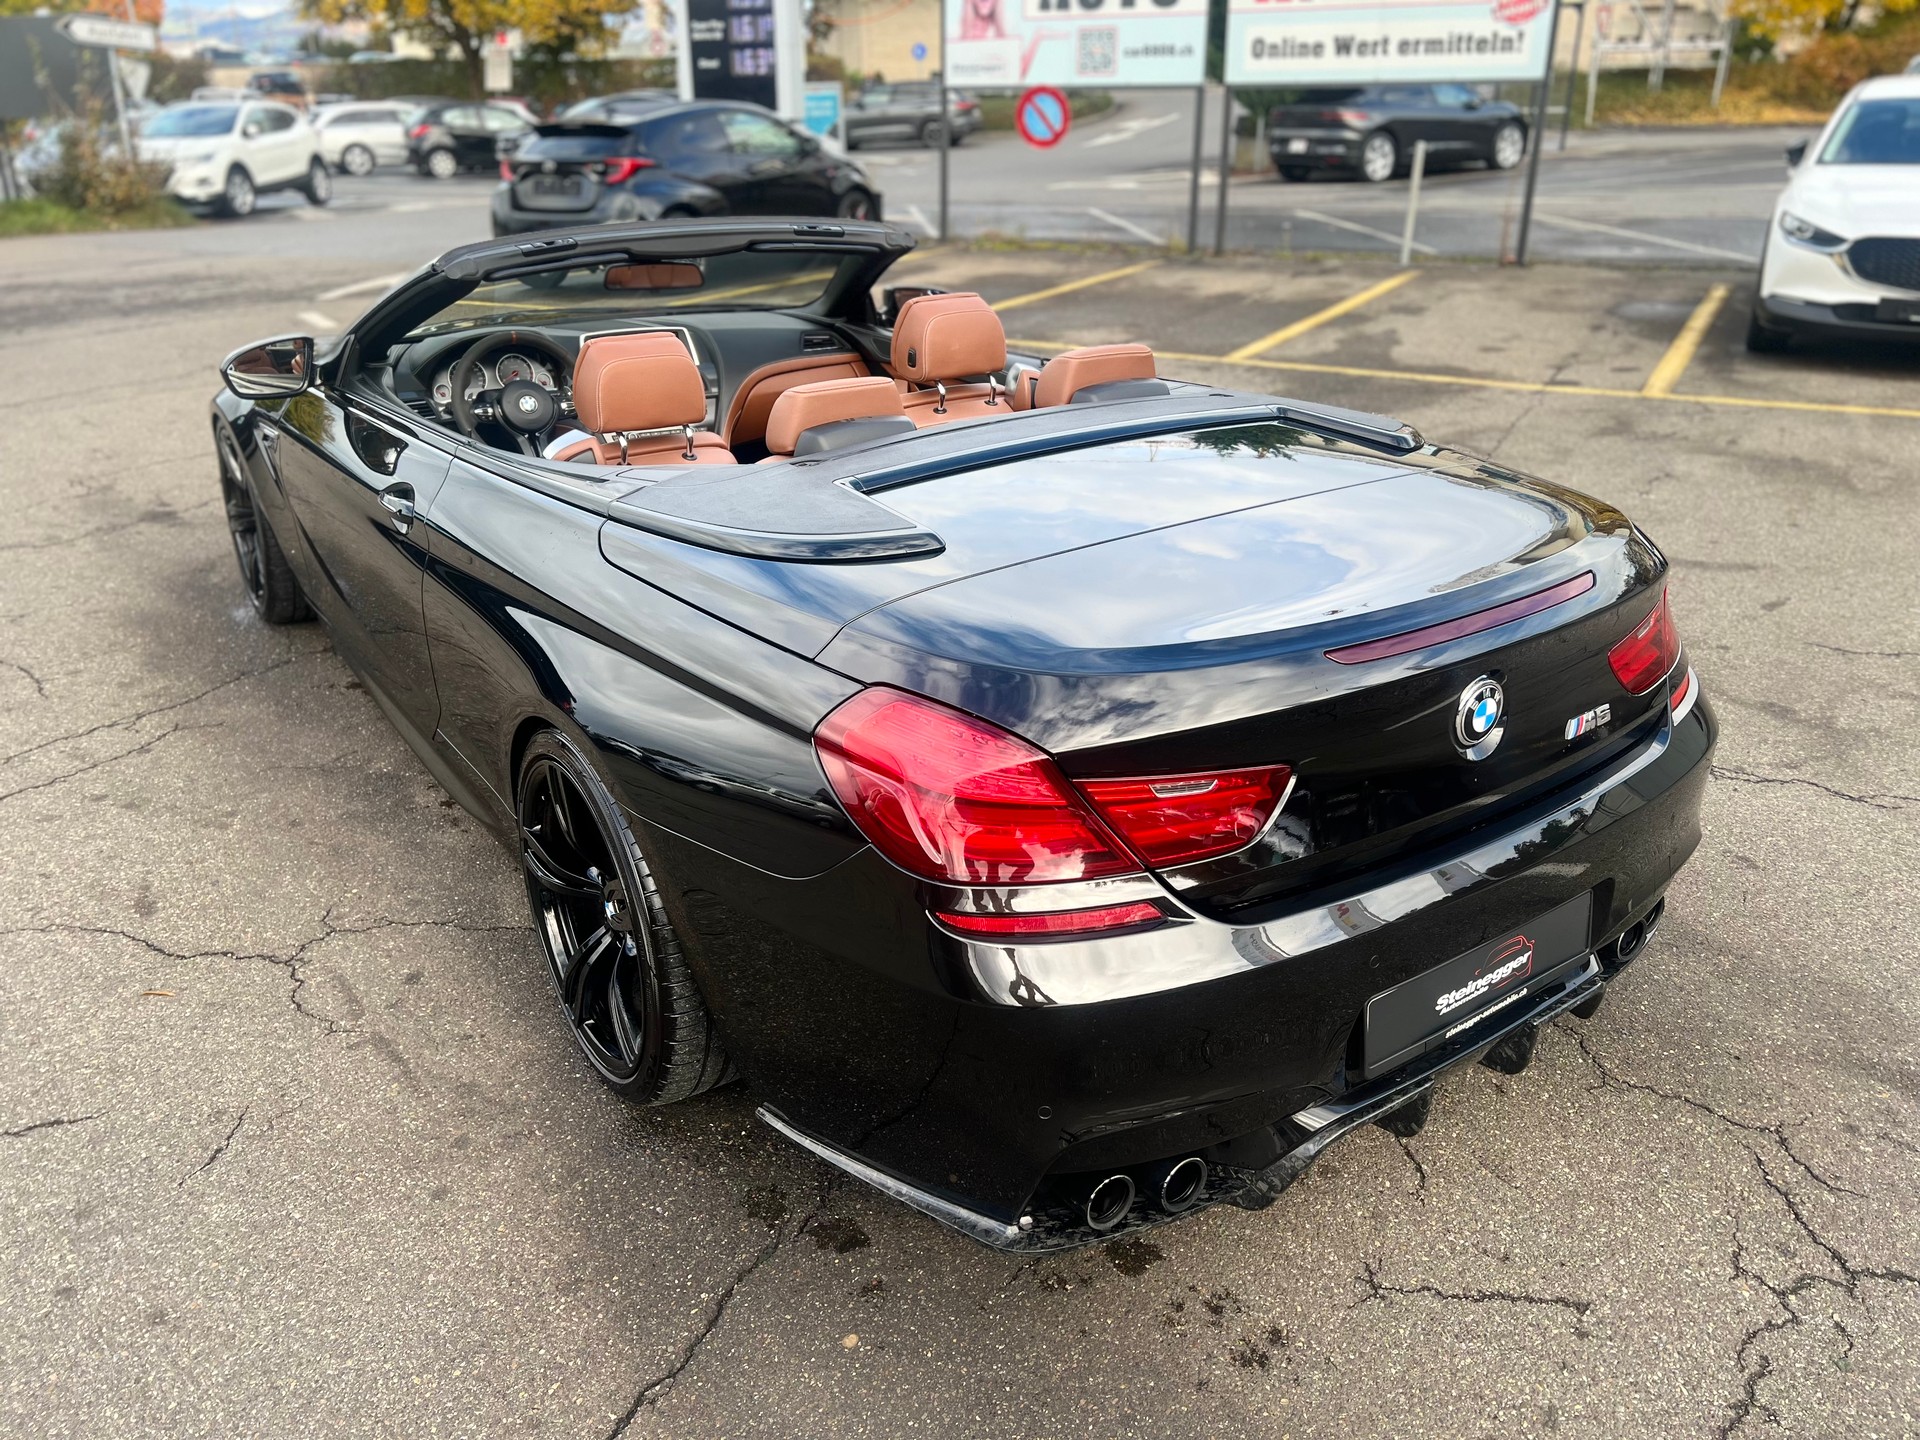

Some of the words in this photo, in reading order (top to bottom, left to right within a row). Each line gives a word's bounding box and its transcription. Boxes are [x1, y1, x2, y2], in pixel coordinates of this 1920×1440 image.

[1252, 36, 1325, 59] Online
[1334, 34, 1390, 57] Wert
[1398, 30, 1525, 56] ermitteln!
[1435, 951, 1532, 1011] Steinegger
[1439, 985, 1490, 1016] Automobile
